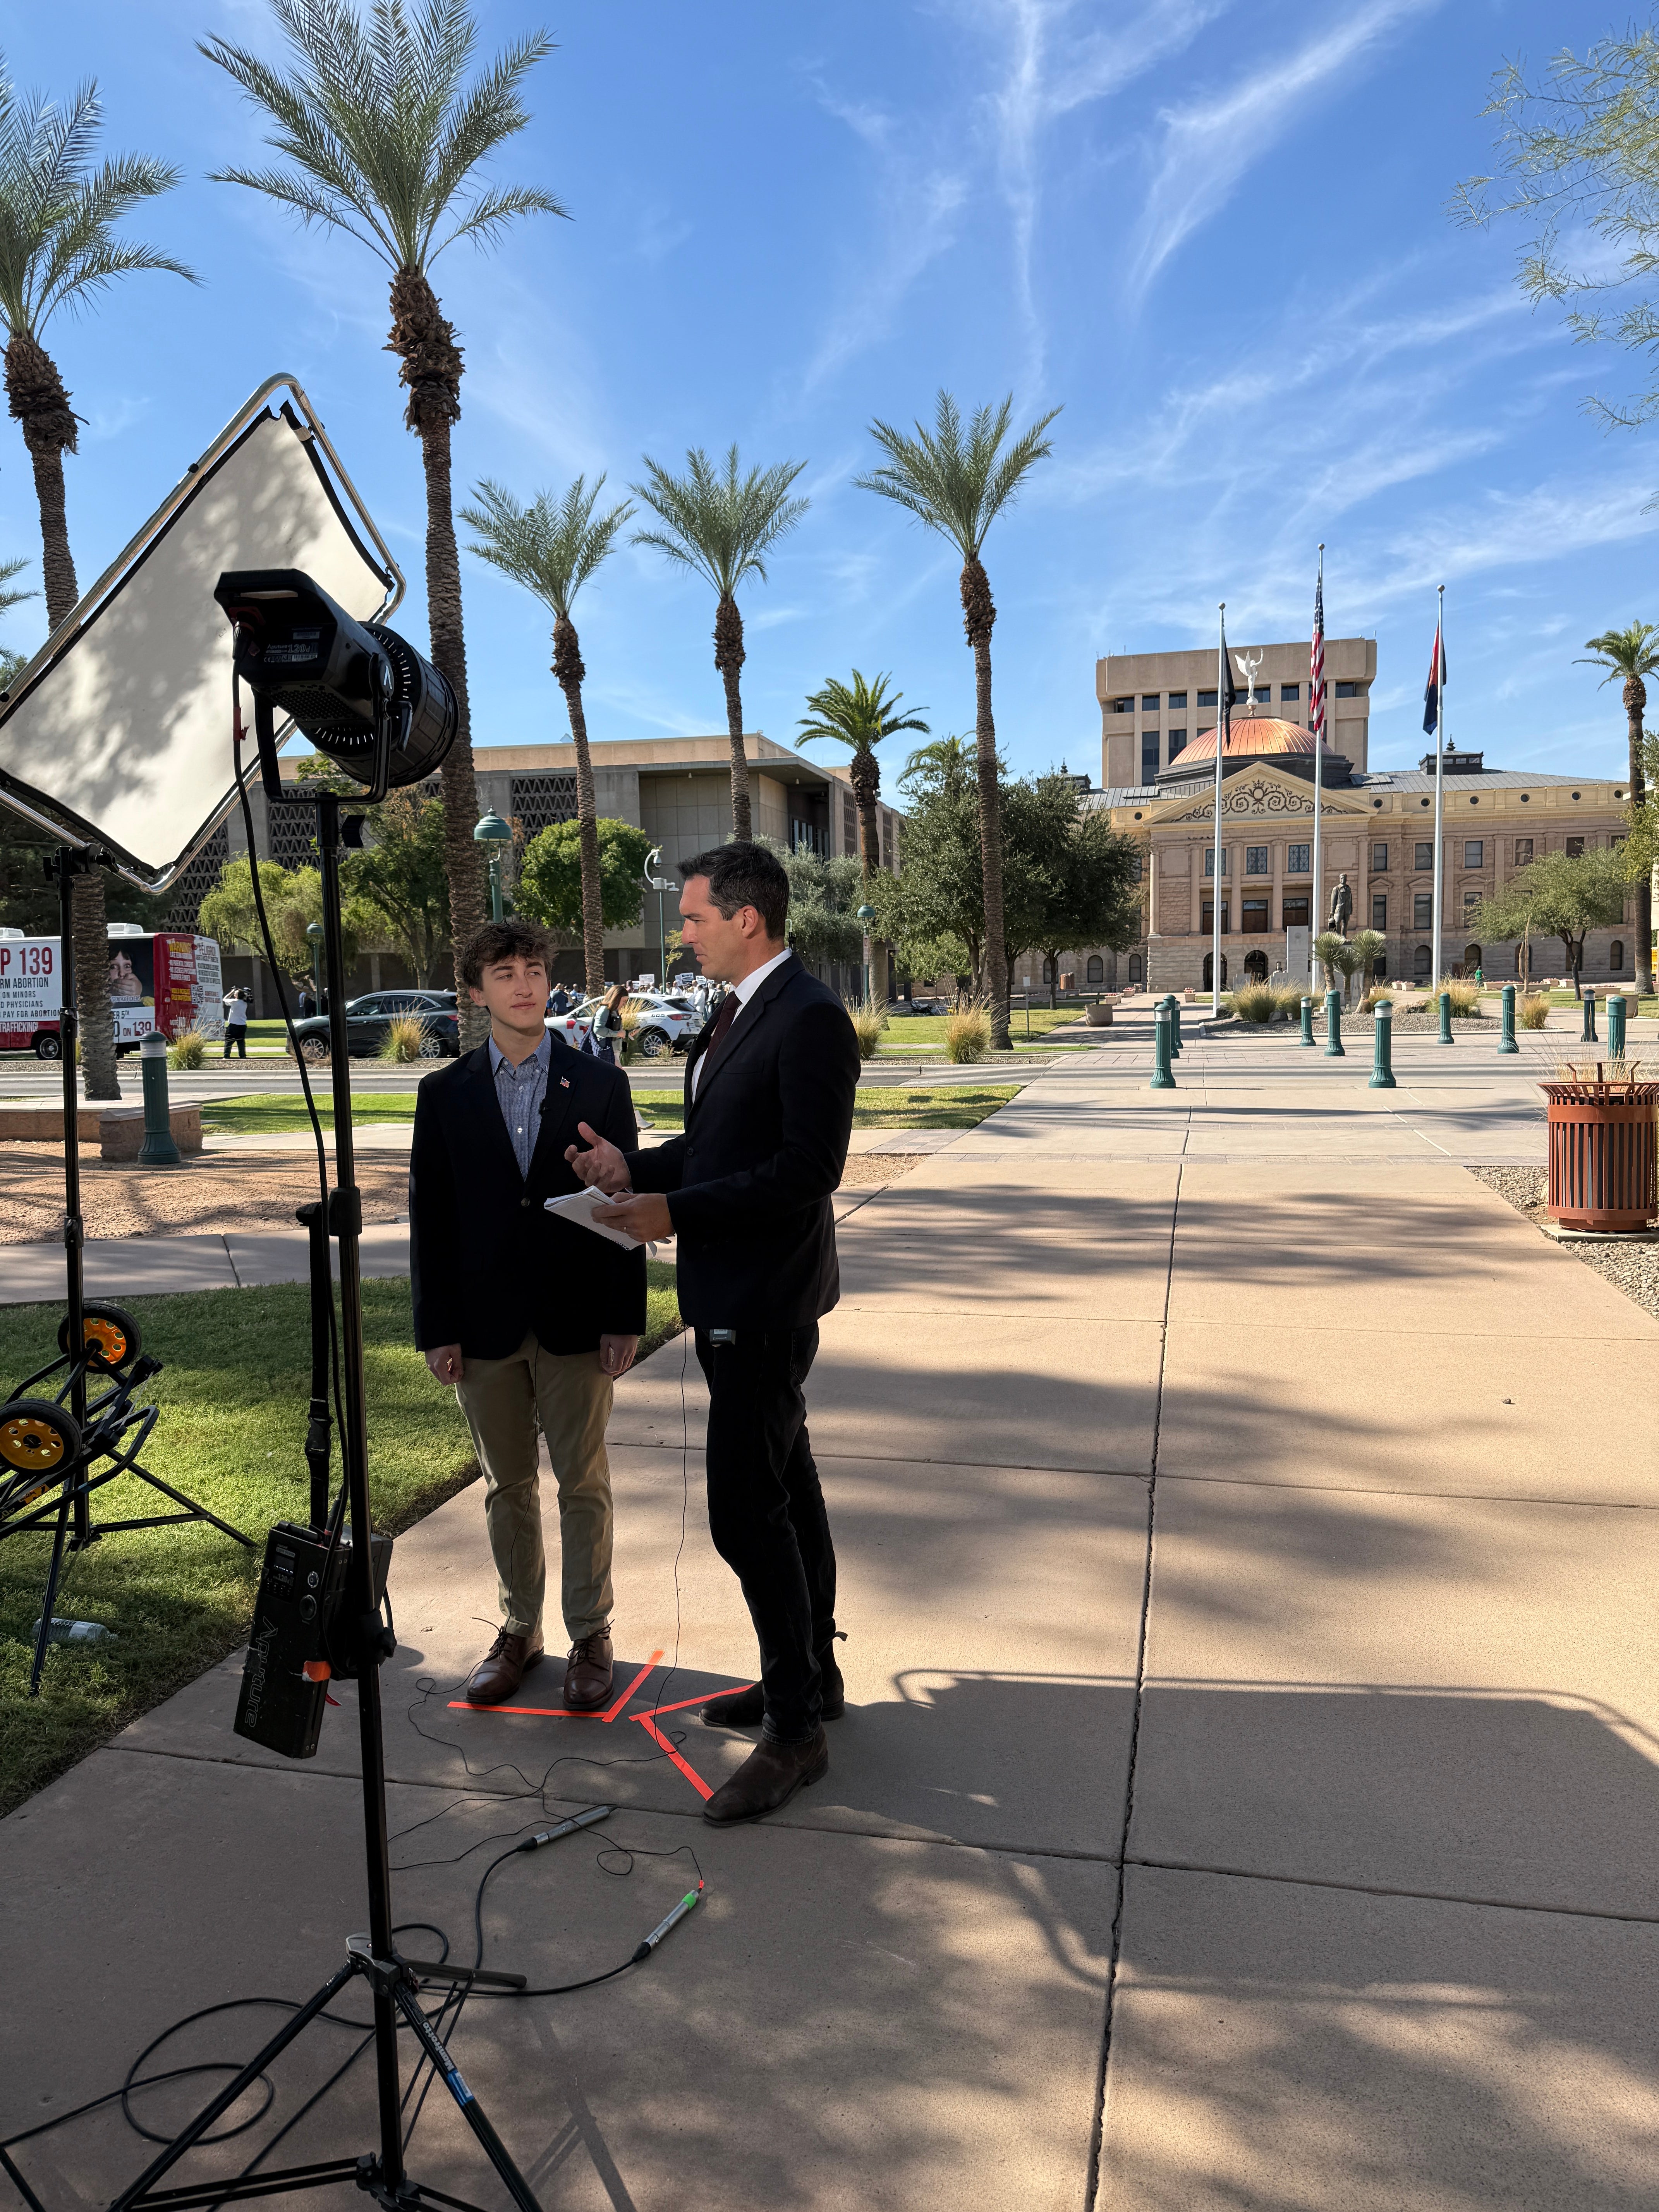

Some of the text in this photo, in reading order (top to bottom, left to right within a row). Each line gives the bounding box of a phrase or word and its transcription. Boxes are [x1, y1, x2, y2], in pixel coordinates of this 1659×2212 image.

[19, 947, 53, 975] 139
[13, 977, 48, 988] ABORTION
[0, 1021, 38, 1033] TRAFFICKING!
[123, 1027, 131, 1037] ON
[132, 1021, 152, 1036] 139
[423, 2022, 455, 2071] Manfrotto
